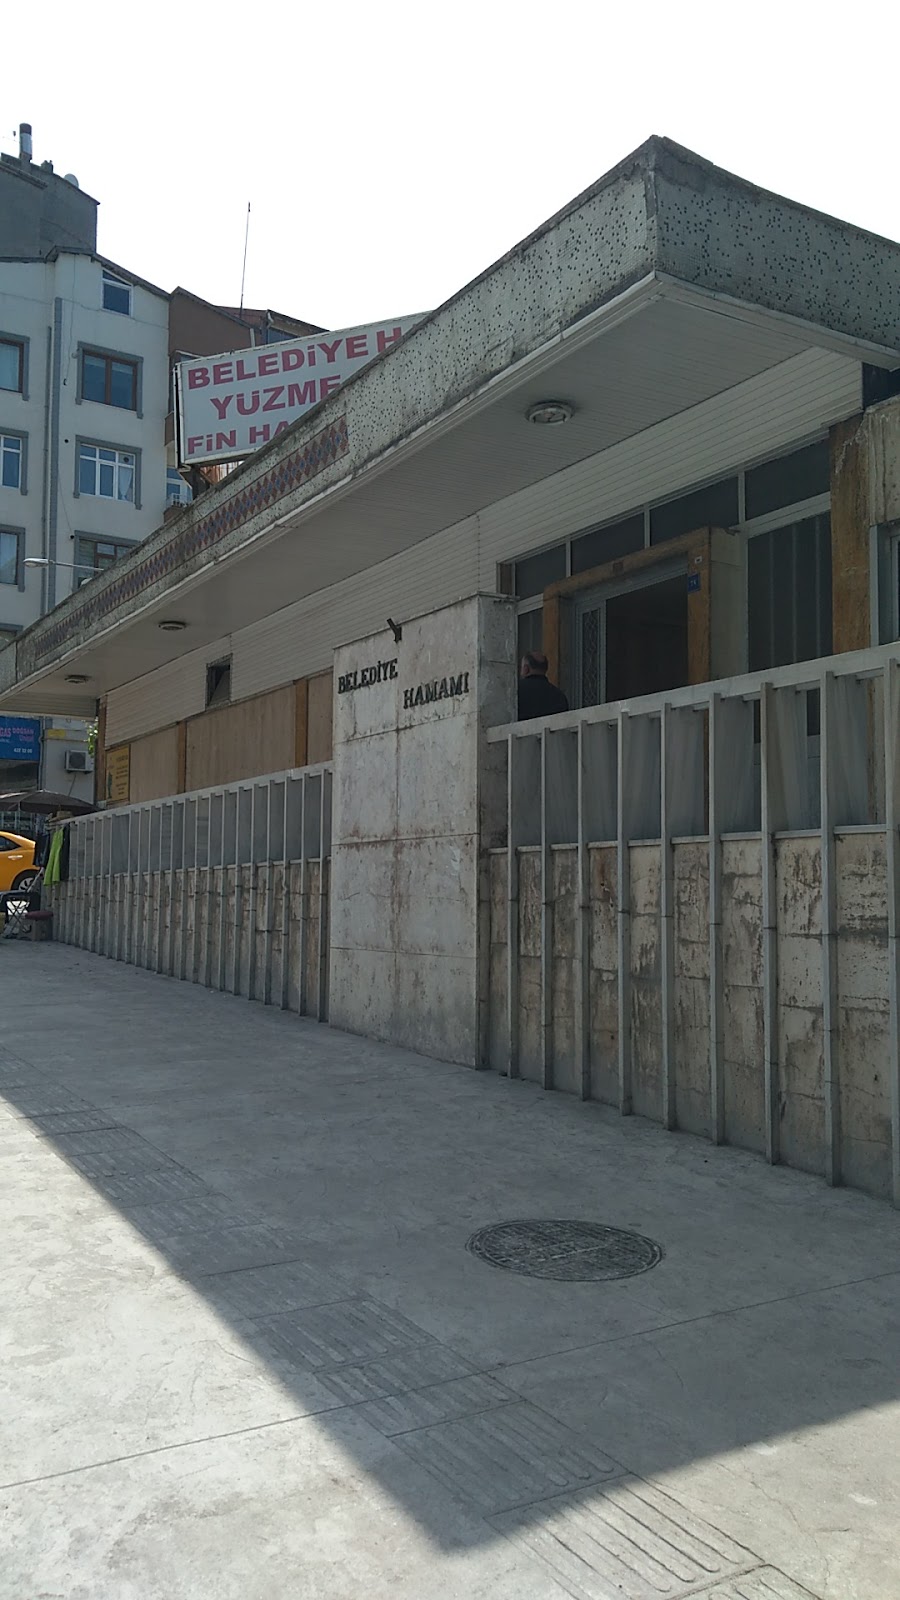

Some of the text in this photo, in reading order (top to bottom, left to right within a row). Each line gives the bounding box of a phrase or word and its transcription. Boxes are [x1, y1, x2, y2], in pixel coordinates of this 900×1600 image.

[210, 374, 342, 420] YÜZME
[338, 657, 399, 694] BELEDİYE
[403, 672, 470, 710] HAMAMI
